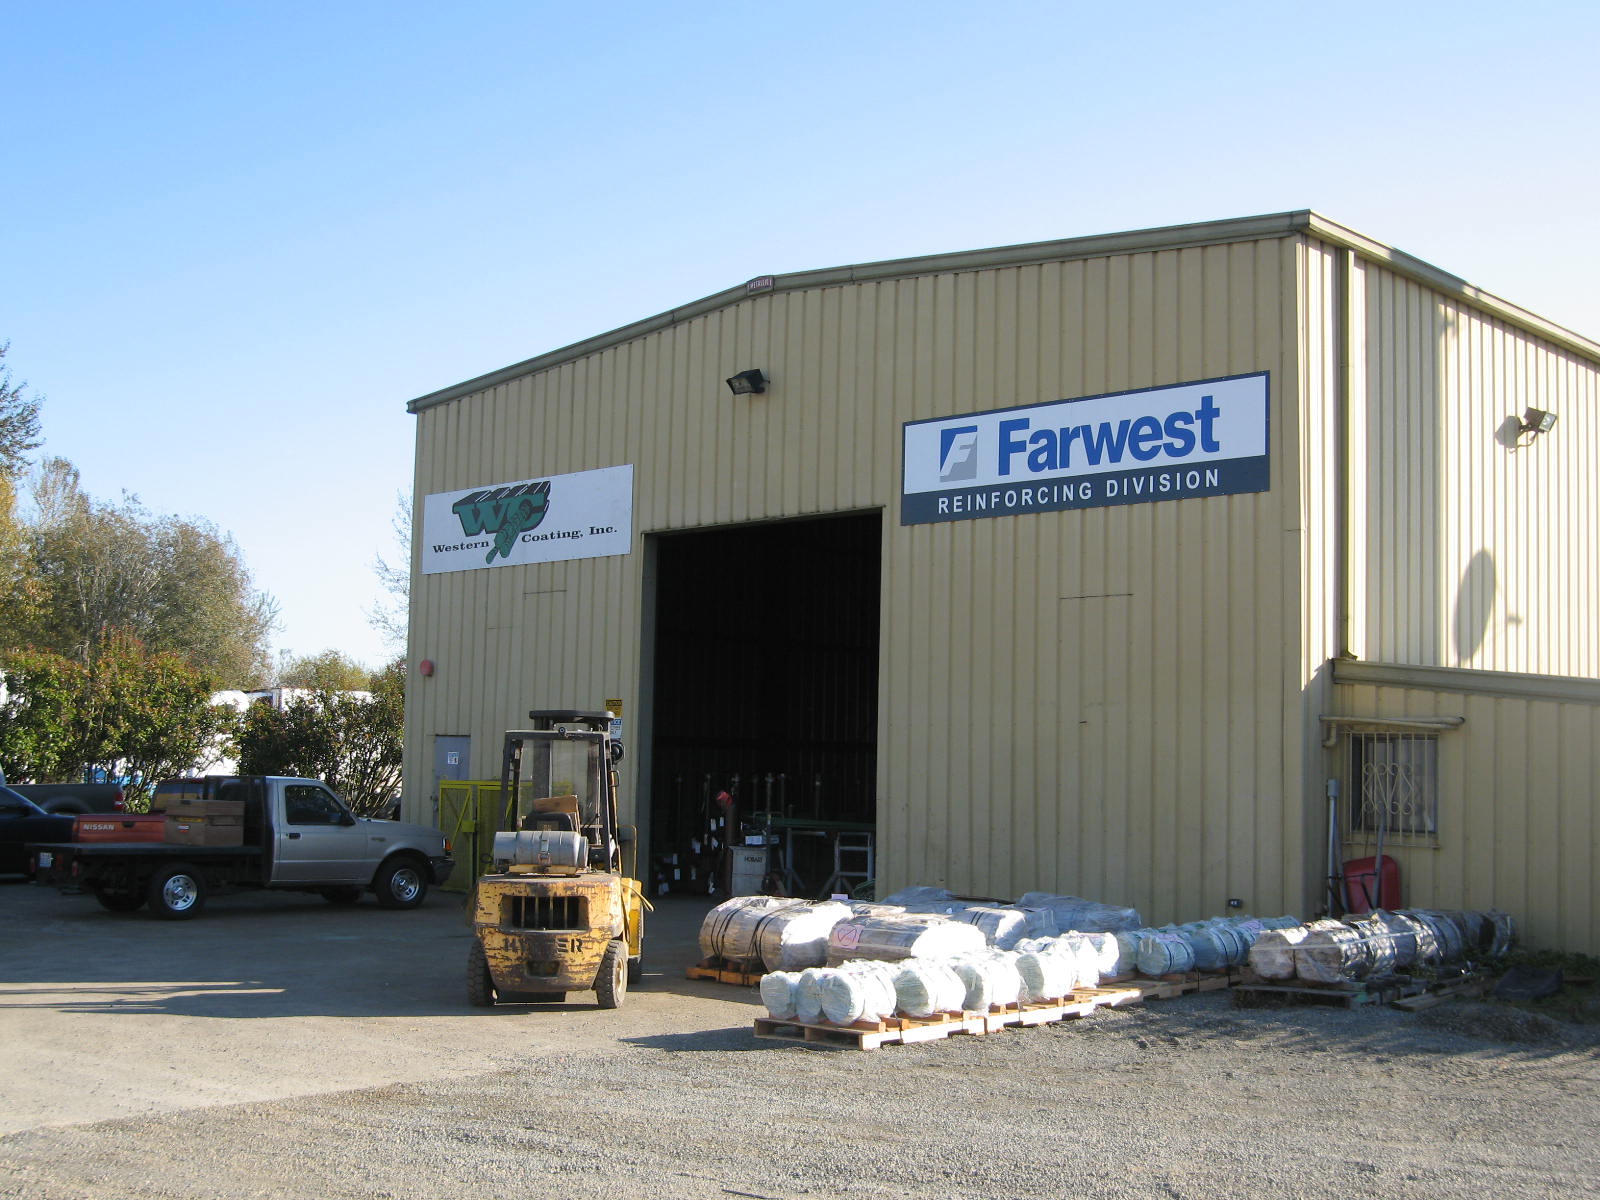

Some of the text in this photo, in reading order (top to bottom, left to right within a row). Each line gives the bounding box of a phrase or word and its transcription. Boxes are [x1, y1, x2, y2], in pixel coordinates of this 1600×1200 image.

[998, 395, 1220, 475] Farwest
[938, 468, 1219, 514] REINFORCING DIVISION
[432, 526, 618, 553] Western Coating, Inc.
